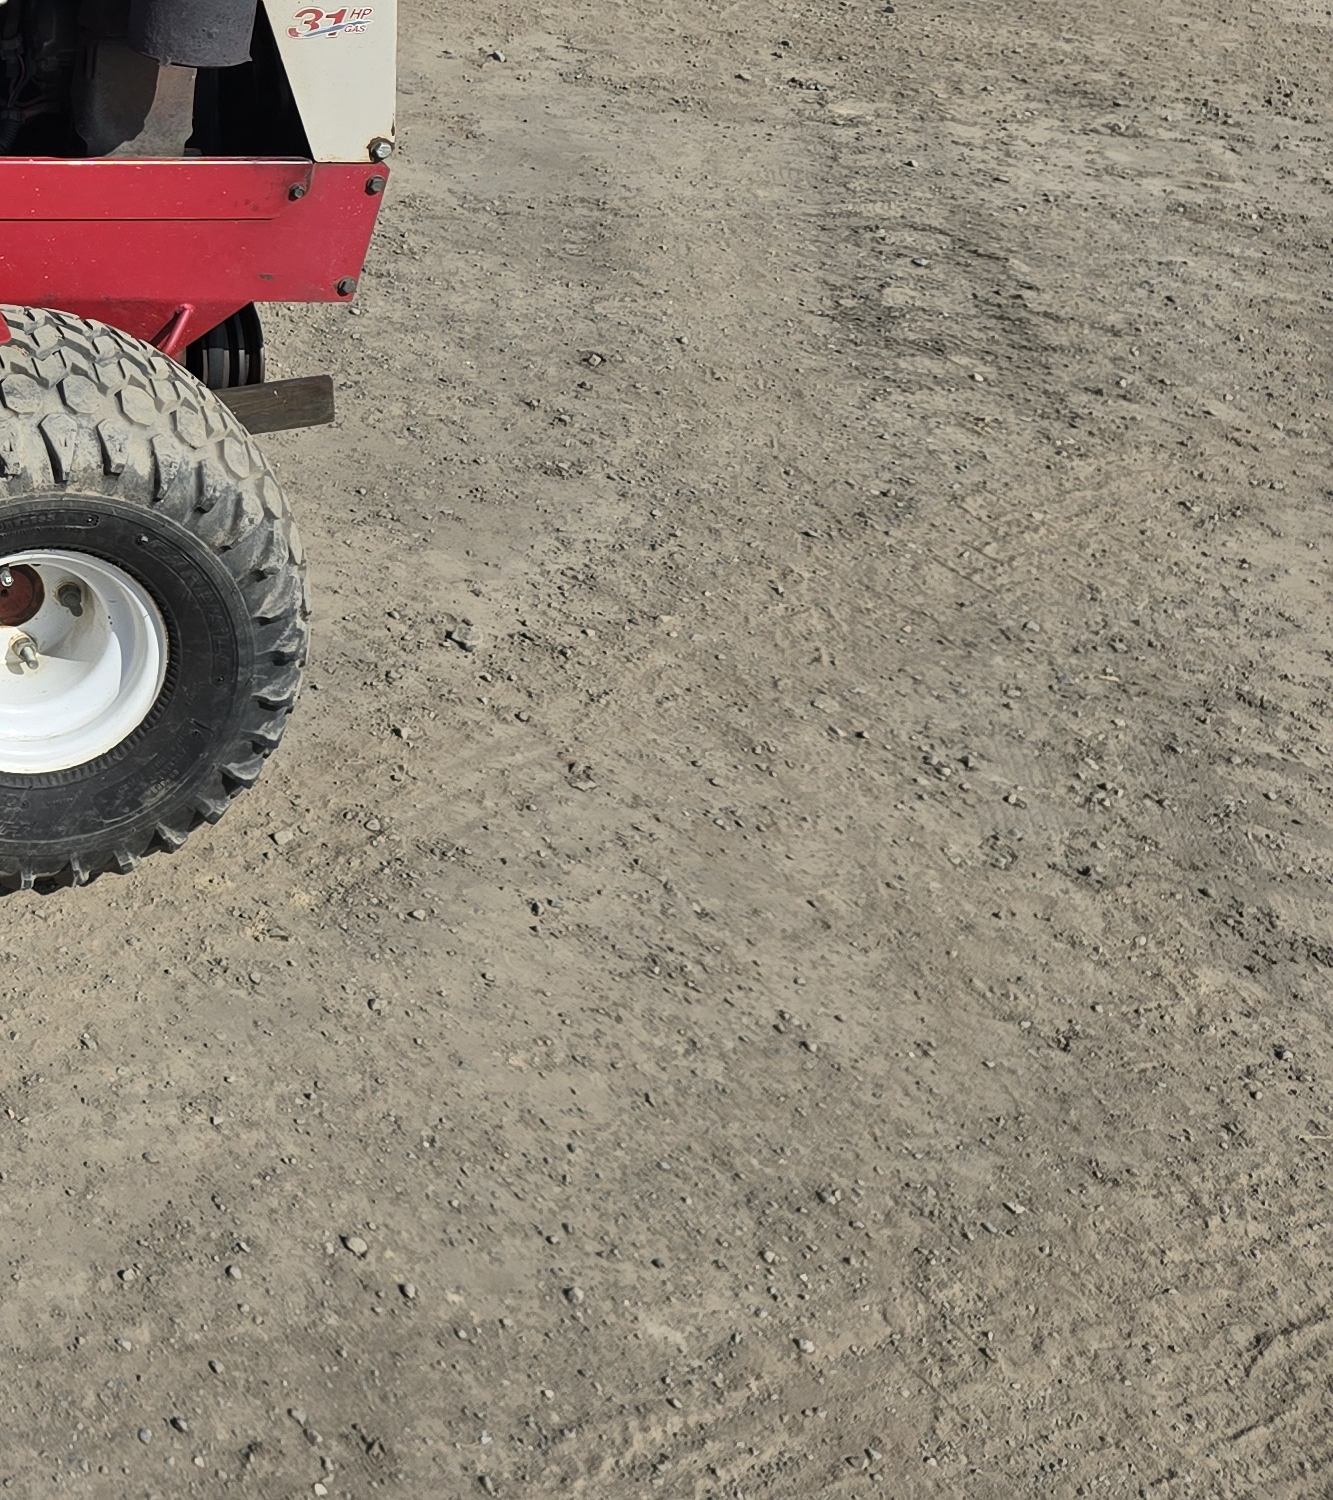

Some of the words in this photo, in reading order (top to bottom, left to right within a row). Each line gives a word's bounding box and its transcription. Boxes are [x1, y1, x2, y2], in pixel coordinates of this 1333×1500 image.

[288, 8, 348, 38] 31
[349, 8, 373, 20] HP
[344, 25, 366, 33] GAS
